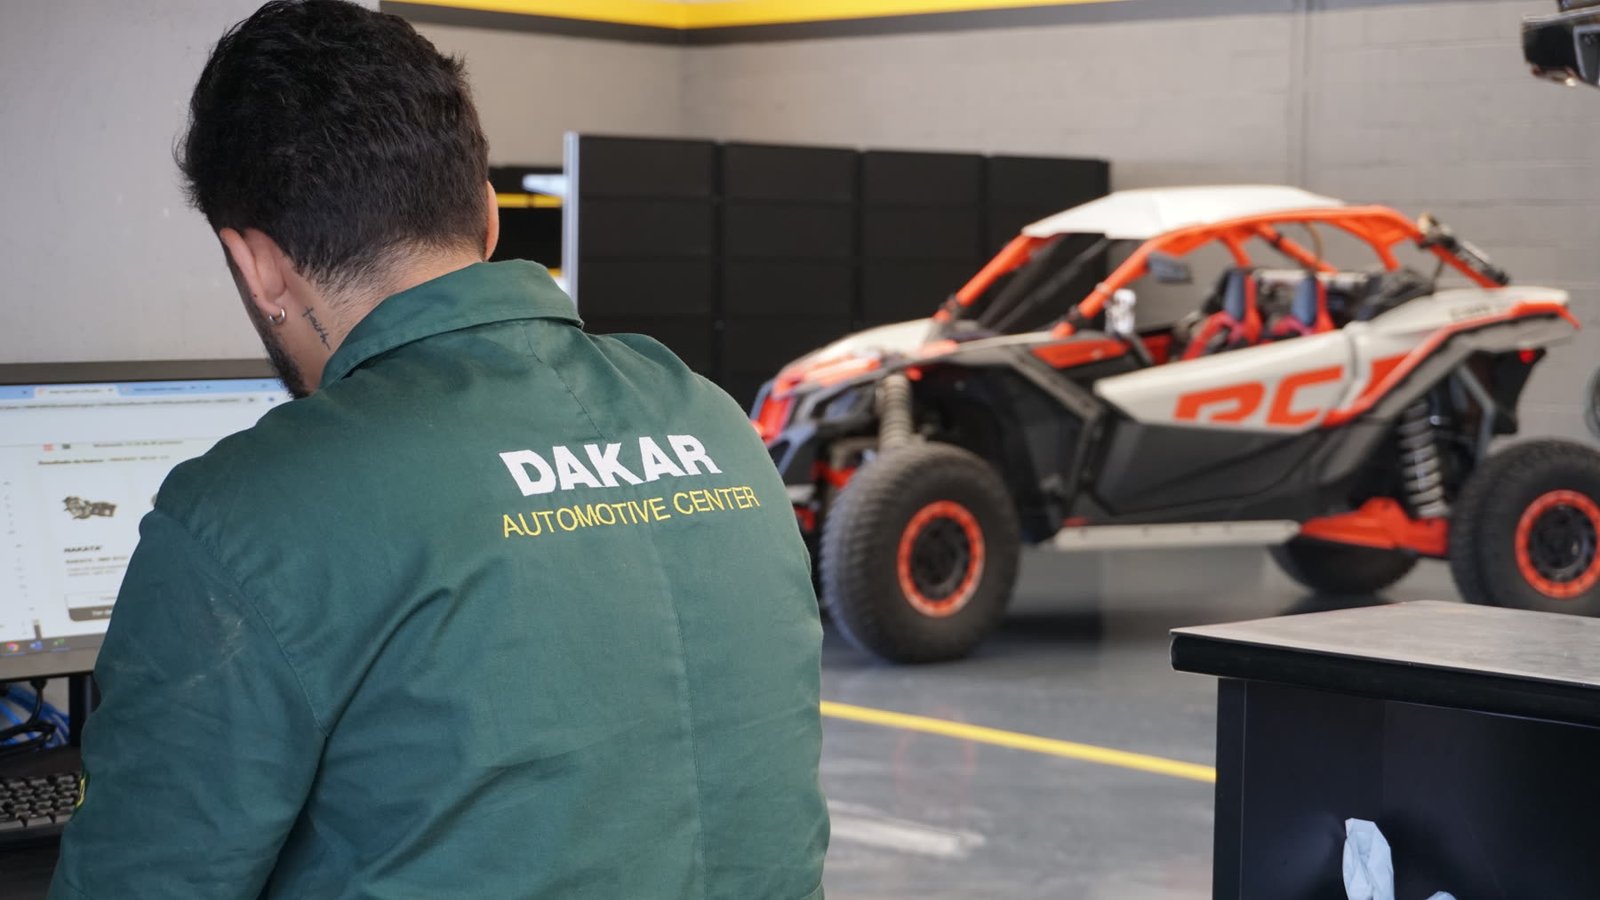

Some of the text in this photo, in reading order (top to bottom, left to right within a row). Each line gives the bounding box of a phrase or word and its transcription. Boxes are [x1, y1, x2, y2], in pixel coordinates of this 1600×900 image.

[499, 434, 722, 496] DAKAR
[502, 486, 761, 538] AUTOMOTIVE CENTER
